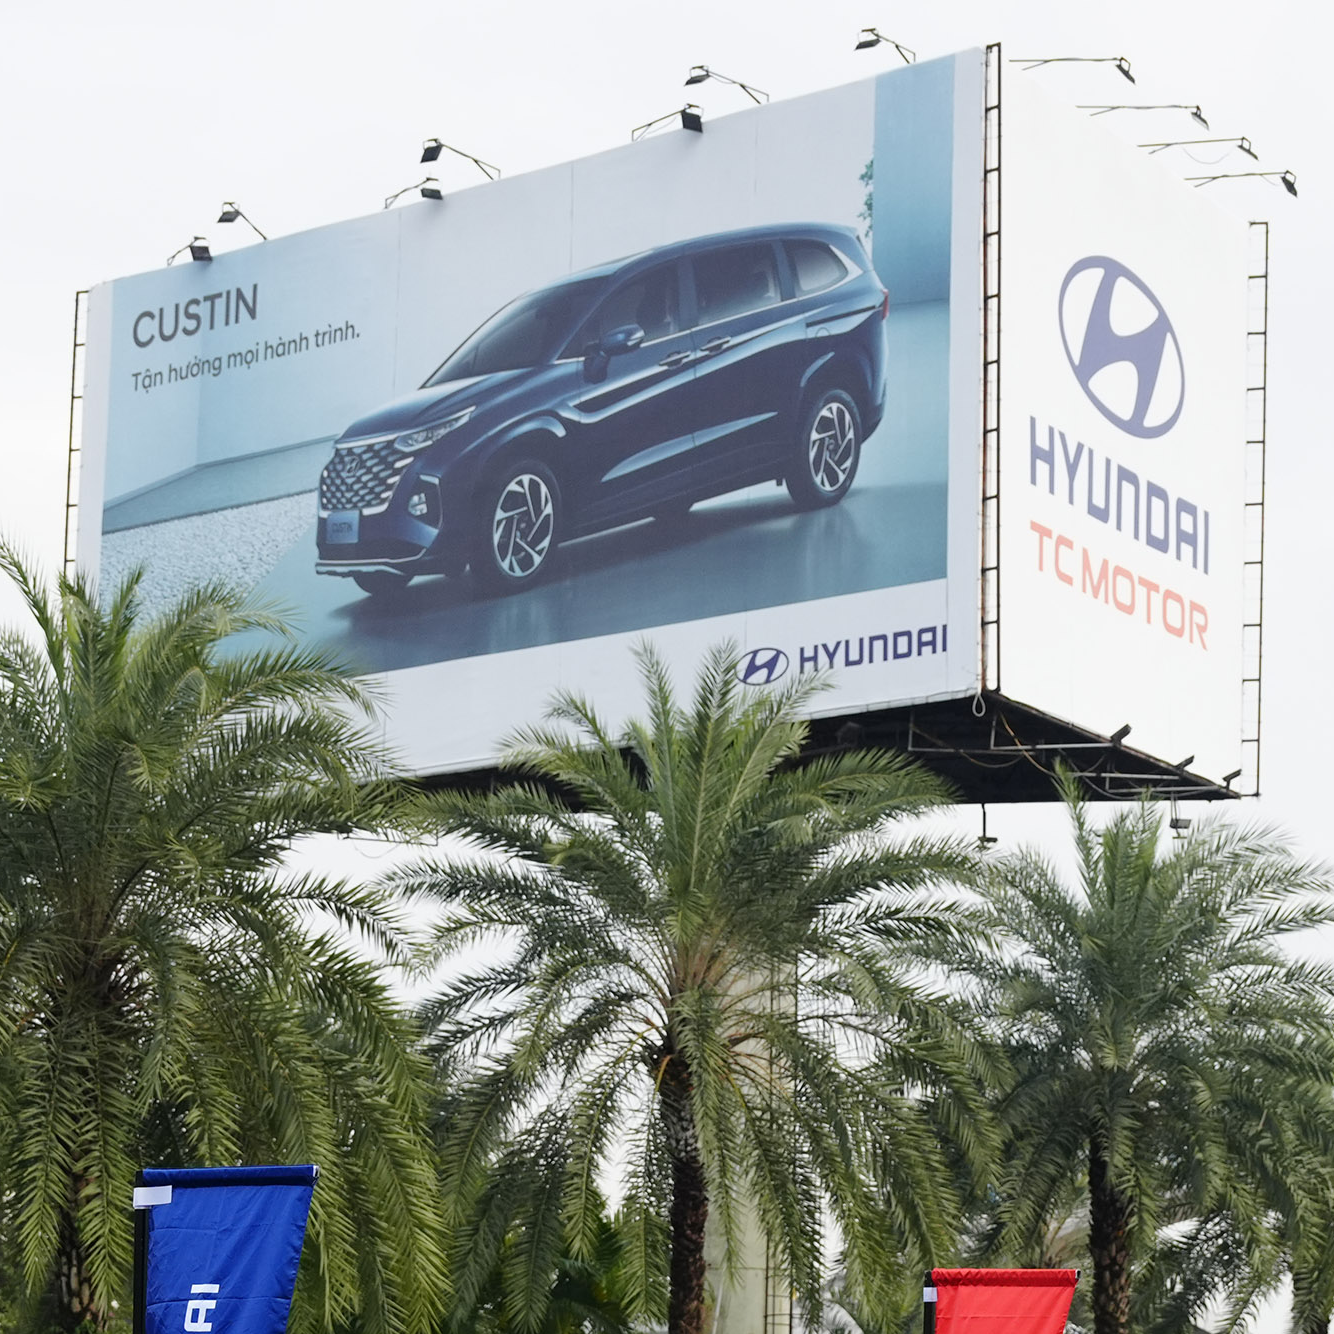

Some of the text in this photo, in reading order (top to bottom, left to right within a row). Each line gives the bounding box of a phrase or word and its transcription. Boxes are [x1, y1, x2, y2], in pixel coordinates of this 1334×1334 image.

[132, 283, 259, 349] CUSTIN
[131, 320, 361, 394] Tận hưởng mọi hành trình.
[1029, 415, 1210, 576] HYUNDAI
[1030, 519, 1209, 652] TC MOTOR
[799, 624, 948, 674] HYUNDAI
